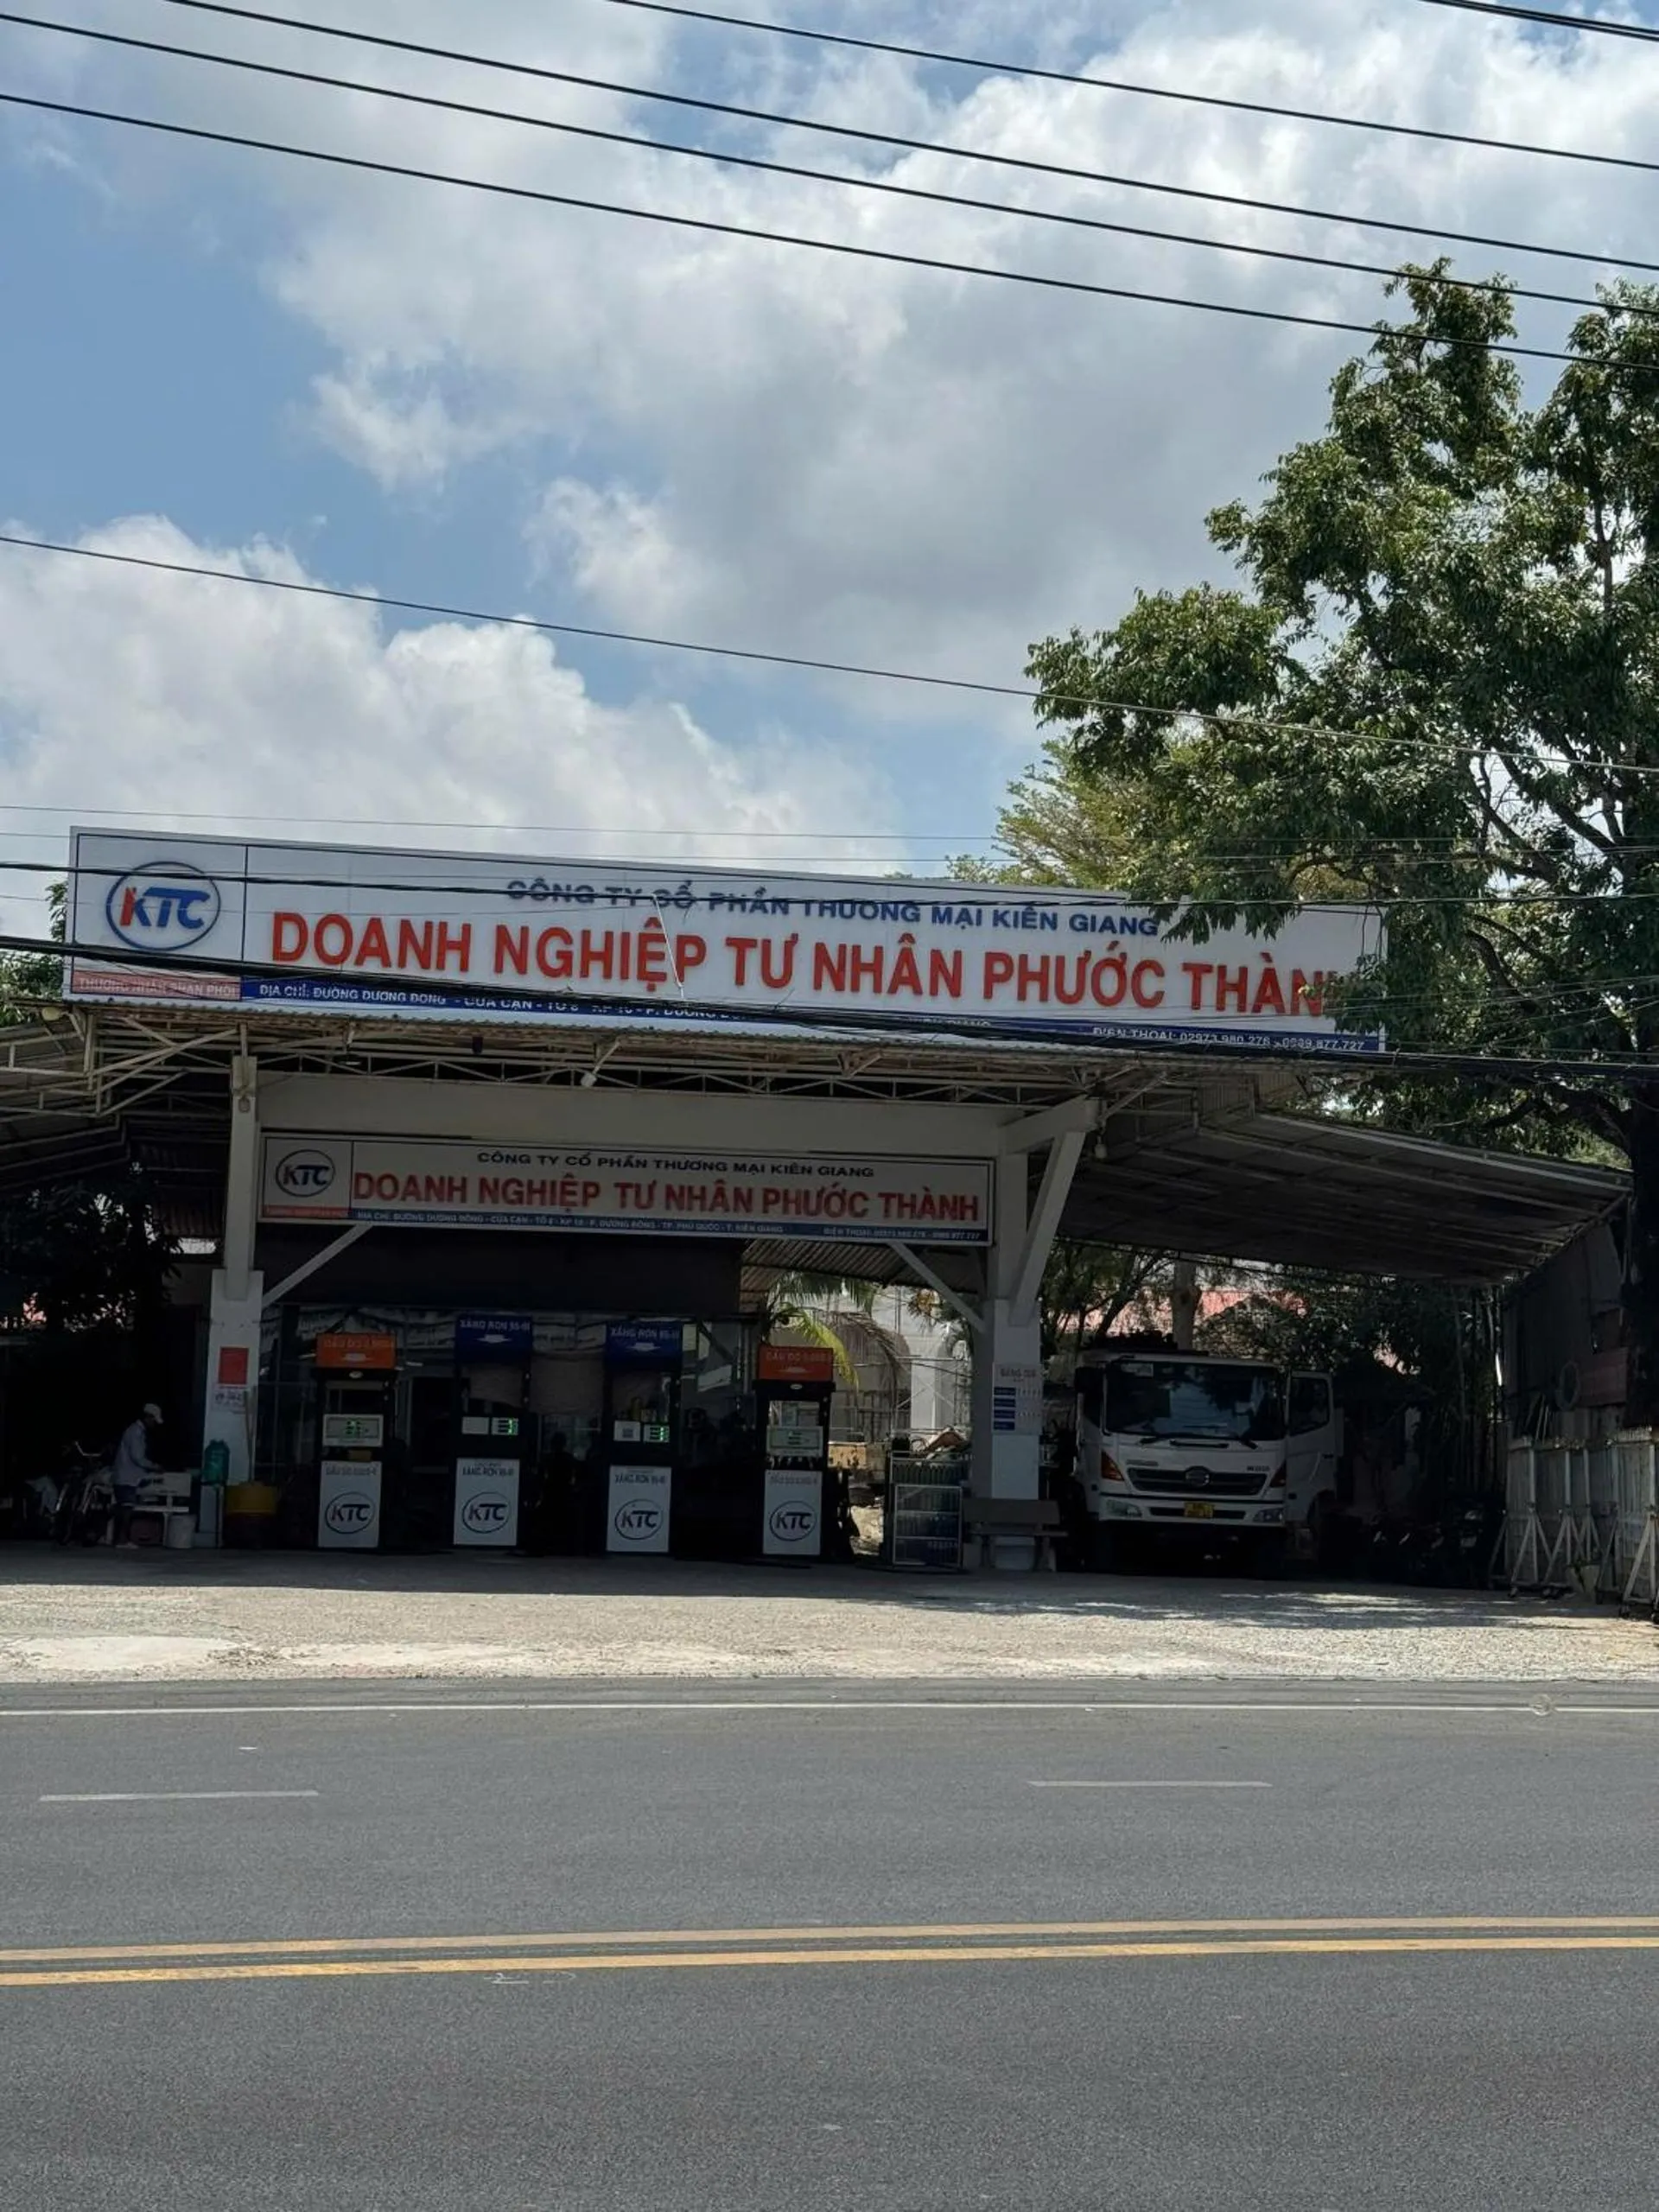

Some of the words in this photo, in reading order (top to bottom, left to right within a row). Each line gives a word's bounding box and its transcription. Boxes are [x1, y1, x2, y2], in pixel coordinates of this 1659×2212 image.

[119, 887, 210, 930] KTC
[606, 887, 642, 906] TY
[931, 906, 982, 930] MẠI
[993, 906, 1058, 931] KIÊN
[1069, 913, 1158, 936] GIANG
[272, 912, 471, 973] DOANH
[494, 917, 707, 991] NGHIỆP
[726, 933, 798, 988] TƯ
[813, 932, 962, 996] NHÂN
[983, 940, 1165, 1009] PHƯỚC
[1181, 952, 1338, 1016] THÀN
[283, 1165, 330, 1185] KTC
[477, 1151, 531, 1165] CÔNG
[537, 1156, 558, 1166] TY
[733, 1161, 765, 1175] MẠI
[771, 1161, 812, 1175] KIÊN
[817, 1165, 874, 1178] GIANG
[354, 1172, 467, 1204] DOANH
[478, 1173, 601, 1213] NGHIỆP
[613, 1179, 657, 1211] TƯ
[664, 1179, 753, 1213] NHÂN
[761, 1182, 869, 1218] PHƯỚC
[878, 1185, 978, 1222] THÀNH
[331, 1503, 371, 1522] KTC
[468, 1503, 506, 1522] KTC
[621, 1510, 658, 1529] KTC
[777, 1511, 811, 1529] KTC
